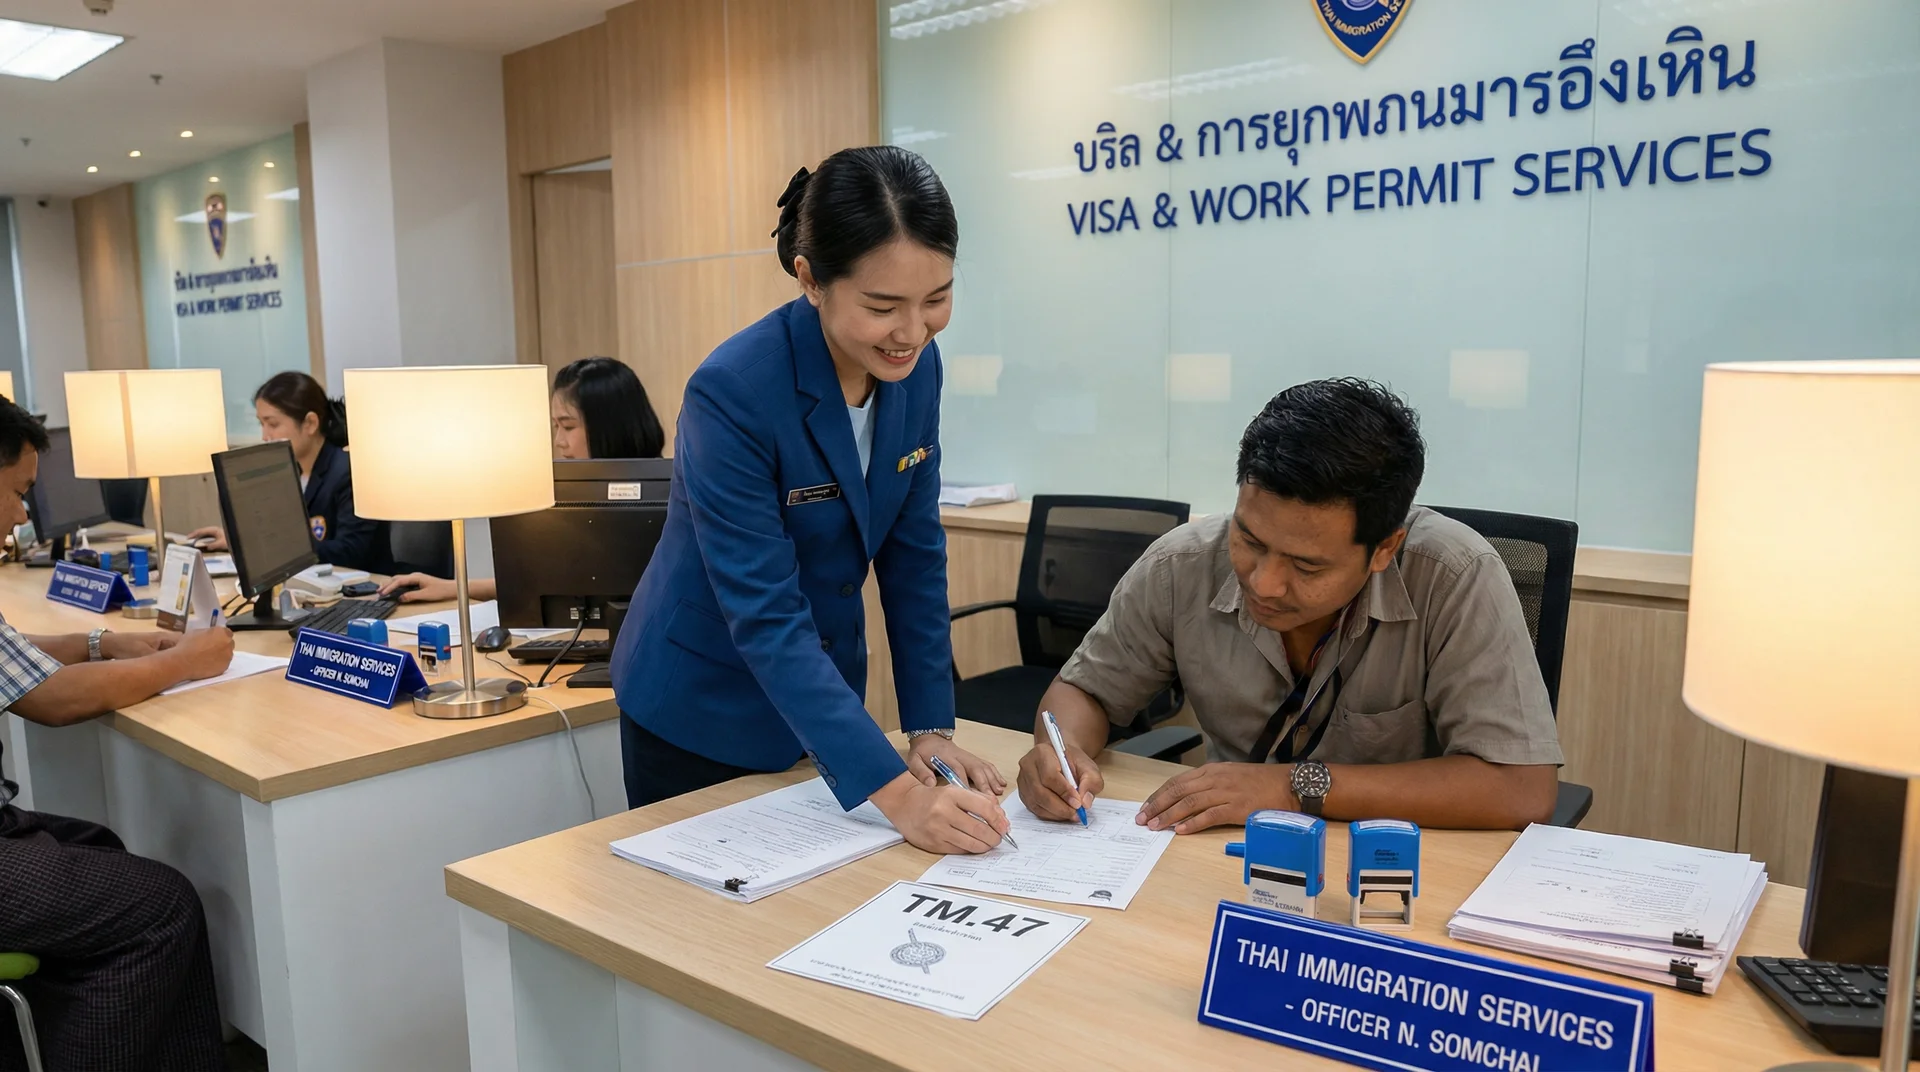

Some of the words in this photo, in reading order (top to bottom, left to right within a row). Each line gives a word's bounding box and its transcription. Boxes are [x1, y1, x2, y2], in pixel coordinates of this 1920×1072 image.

[1321, 0, 1336, 22] THAI
[1073, 121, 1141, 173] บริล
[1156, 123, 1184, 162] &
[1067, 196, 1140, 235] VISA
[1152, 192, 1178, 228] &
[1190, 177, 1311, 225] WORK
[1327, 157, 1495, 213] PERMIT
[1512, 127, 1772, 197] SERVICES
[299, 642, 316, 656] THAI
[315, 646, 360, 668] IMMIGRATION
[360, 657, 397, 678] SERVICES
[902, 893, 1050, 937] TM.47
[1236, 938, 1289, 973] THAI
[1297, 952, 1470, 1016] IMMIGRATION
[1477, 993, 1614, 1050] SERVICES
[1301, 998, 1390, 1041] OFFICER
[1397, 1023, 1420, 1049] N.
[1429, 1029, 1540, 1072] SOMCHAI
